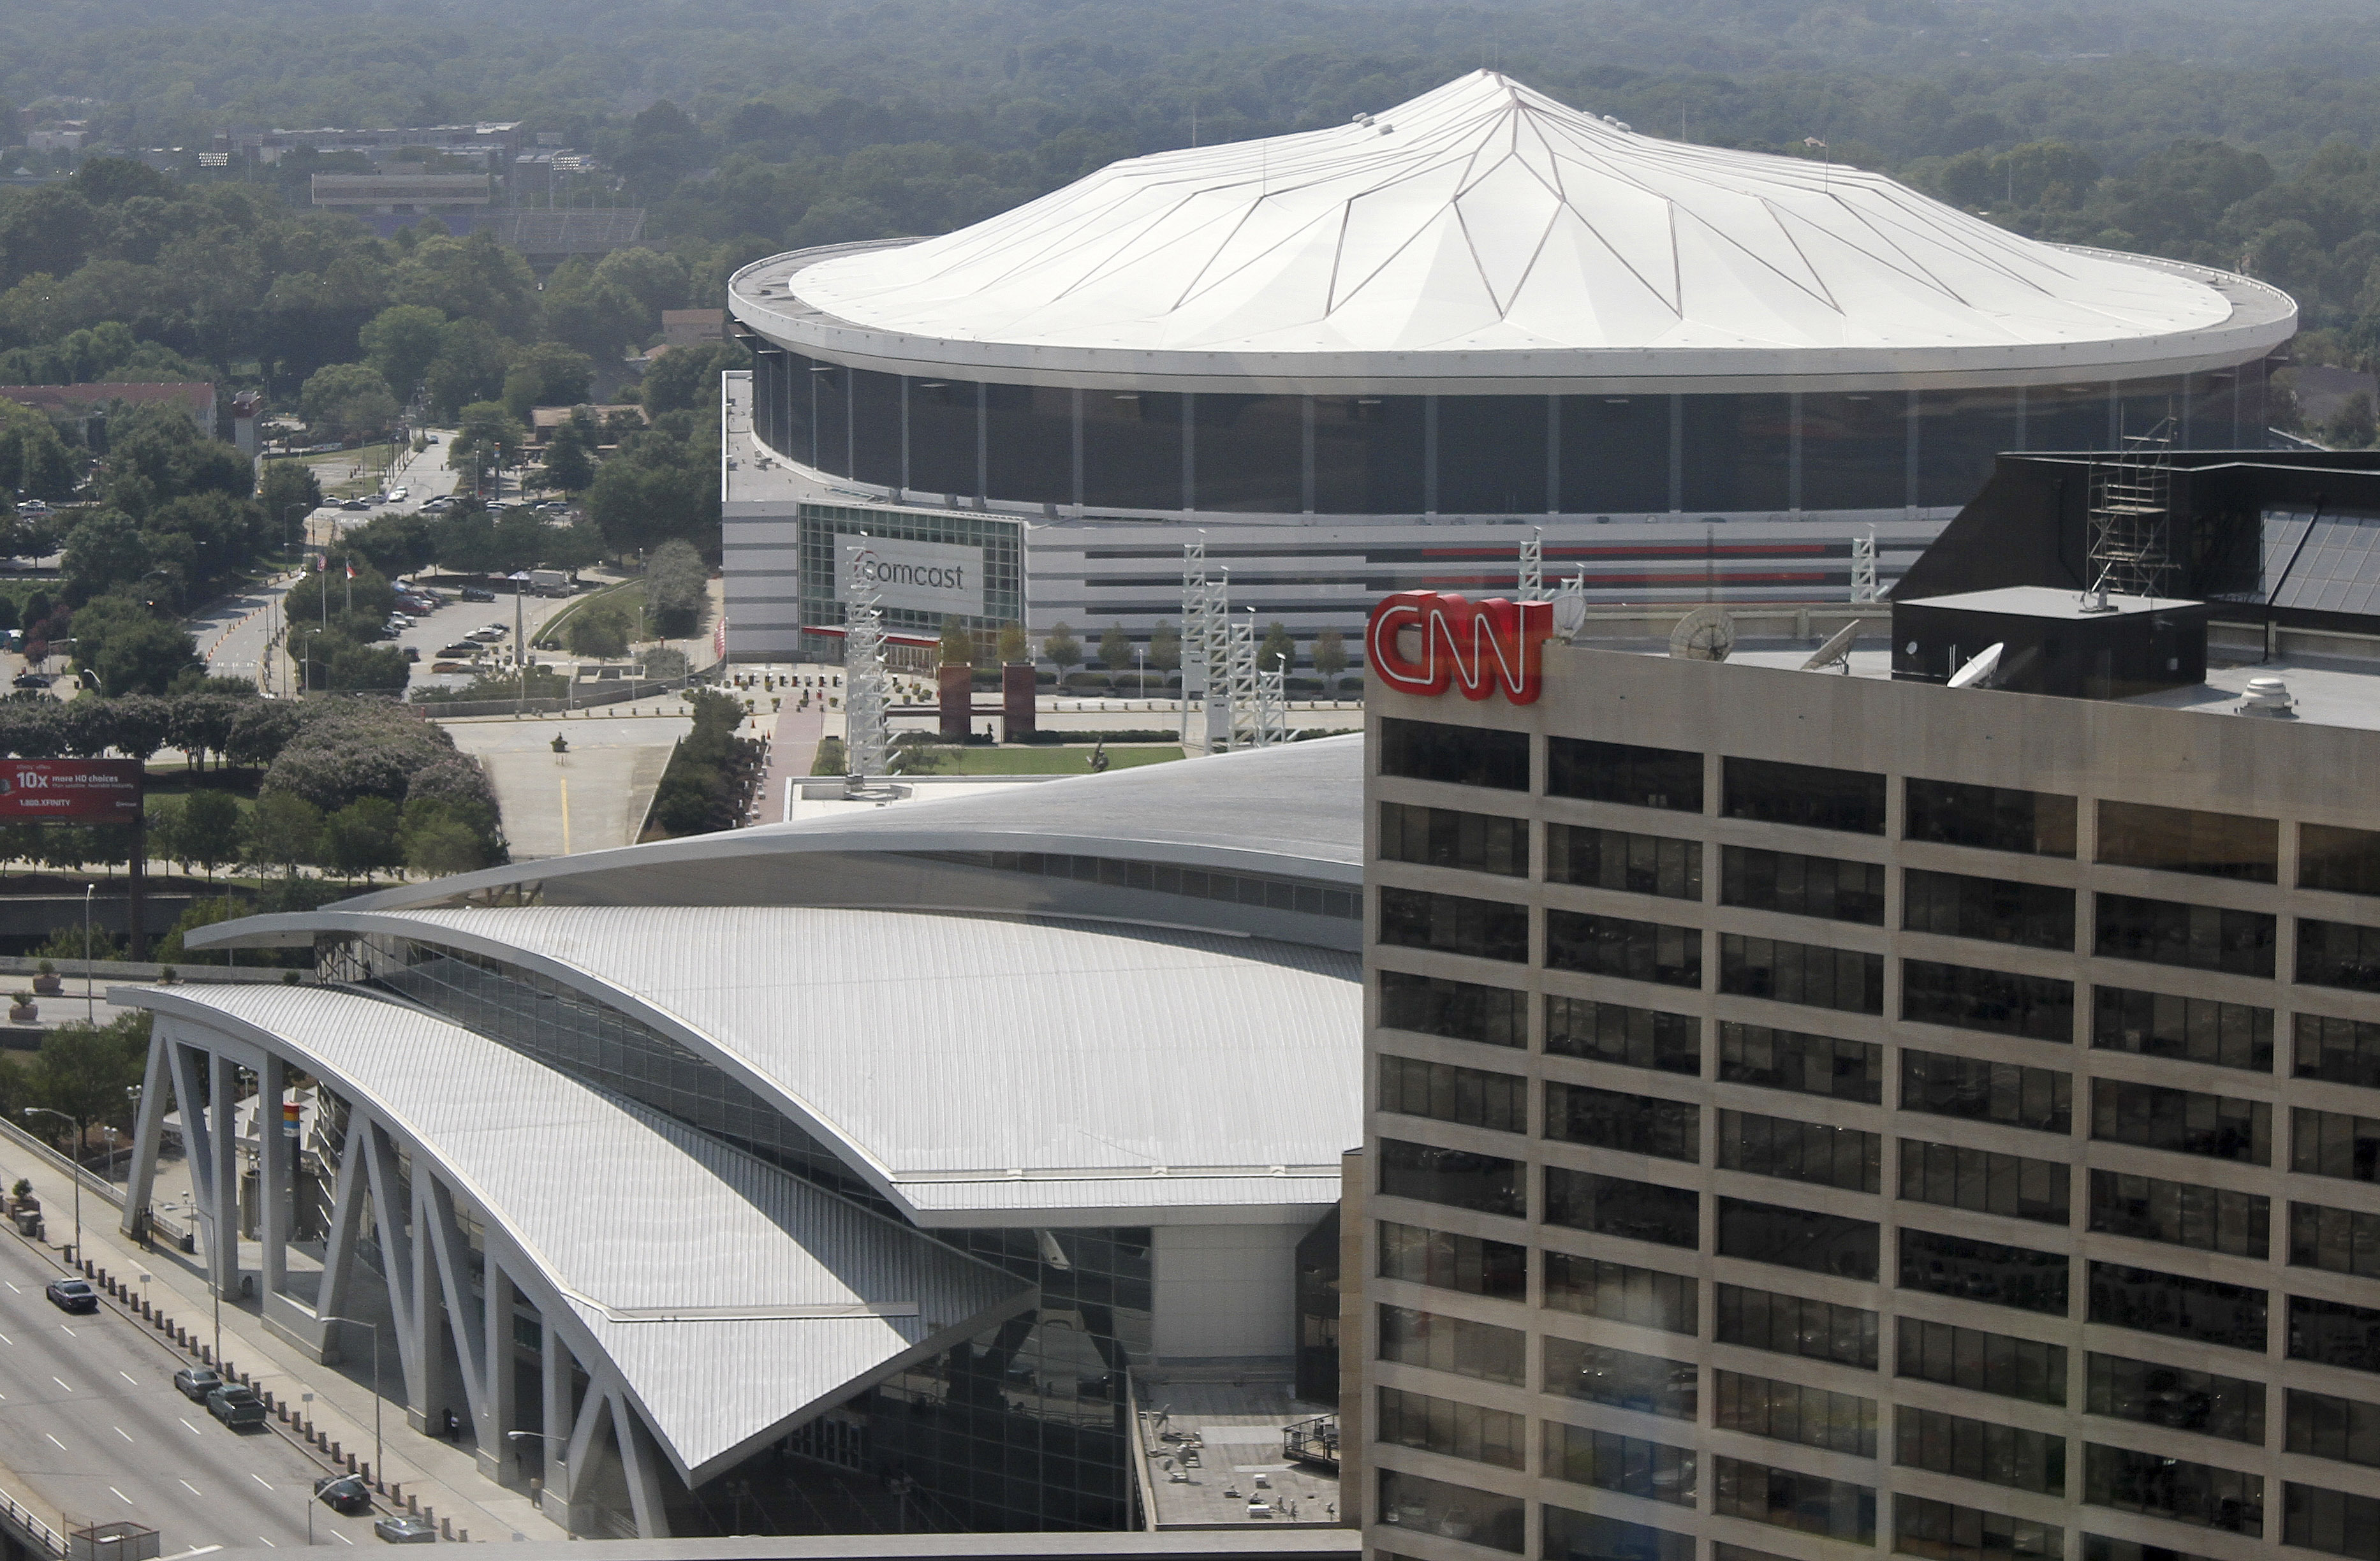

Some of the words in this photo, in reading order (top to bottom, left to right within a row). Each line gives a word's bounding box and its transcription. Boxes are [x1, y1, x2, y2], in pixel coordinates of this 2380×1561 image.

[863, 559, 964, 589] comcast
[1367, 590, 1552, 706] CNN
[17, 772, 48, 788] 10x
[88, 774, 119, 782] choices
